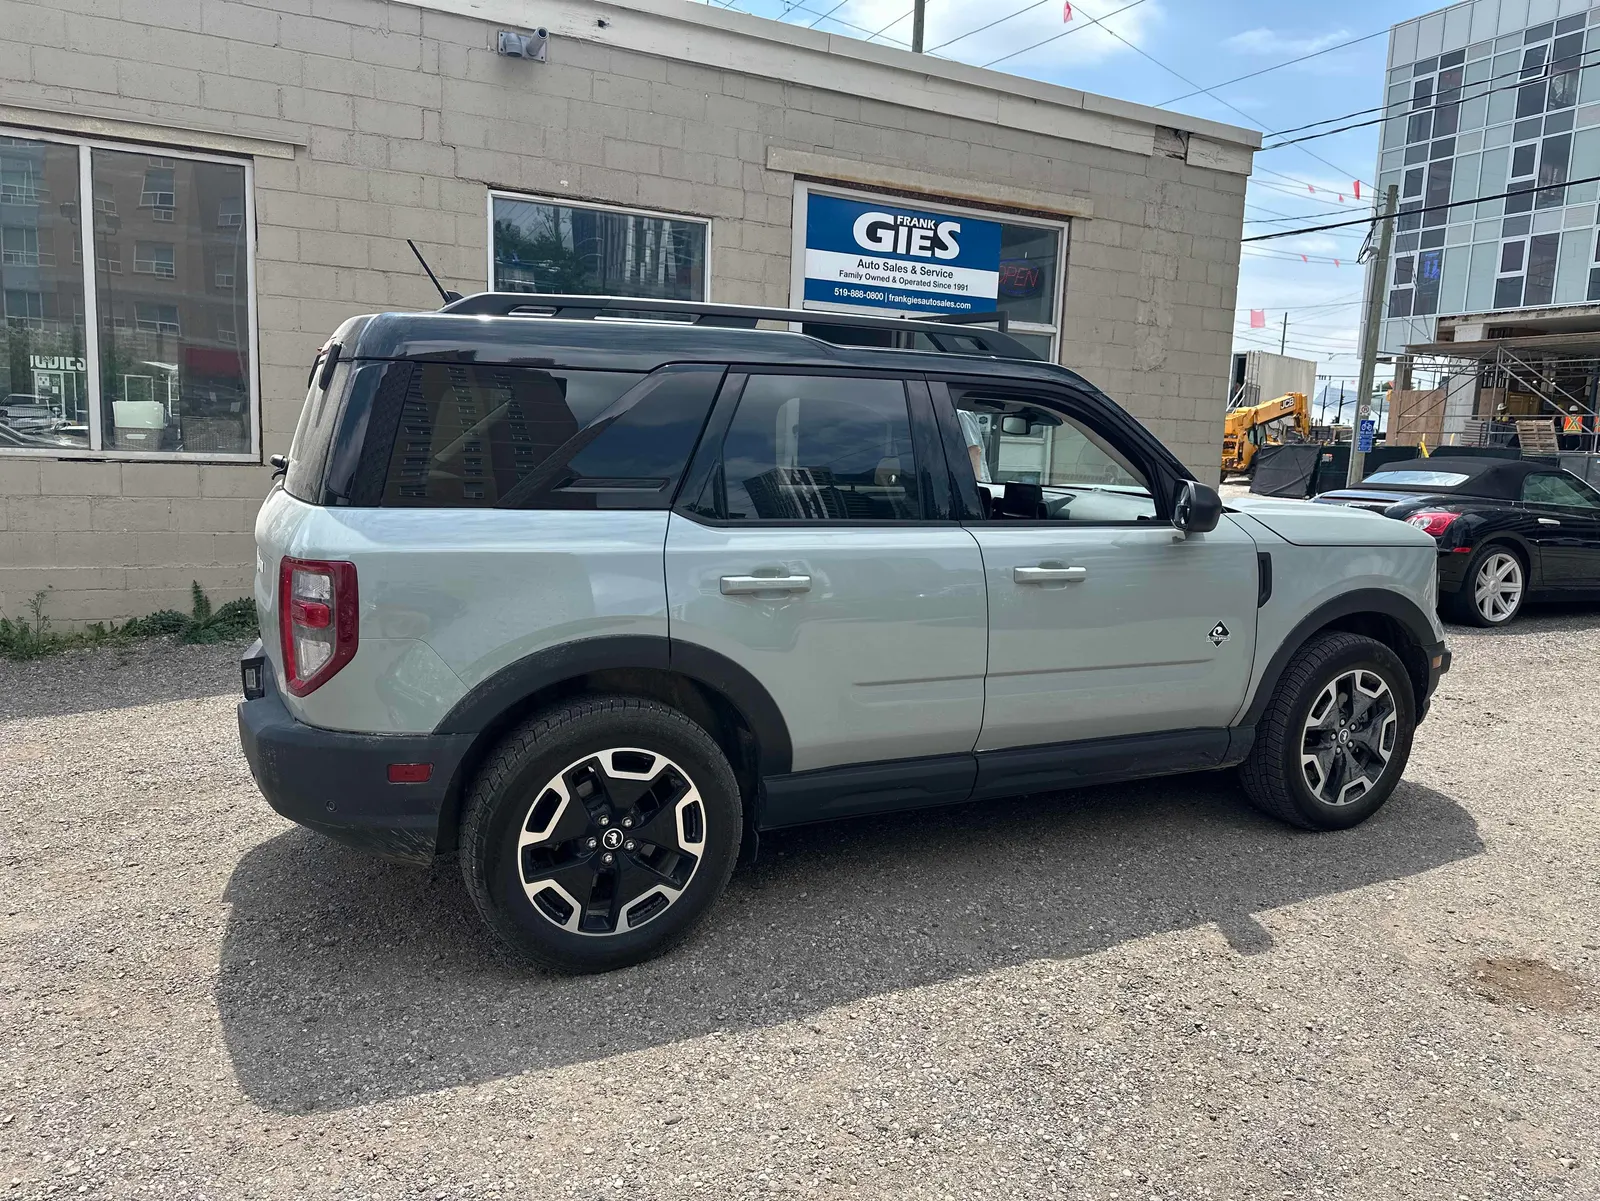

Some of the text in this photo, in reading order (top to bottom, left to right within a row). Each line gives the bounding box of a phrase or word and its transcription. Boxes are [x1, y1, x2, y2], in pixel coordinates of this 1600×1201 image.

[897, 215, 935, 229] FRANK
[853, 211, 961, 260] GIES
[857, 259, 954, 279] Auto Sales & Service
[839, 270, 969, 292] Family Owned & Operated Since 1991
[888, 293, 971, 310] frankgiesautosales.com
[1280, 397, 1295, 410] JCB
